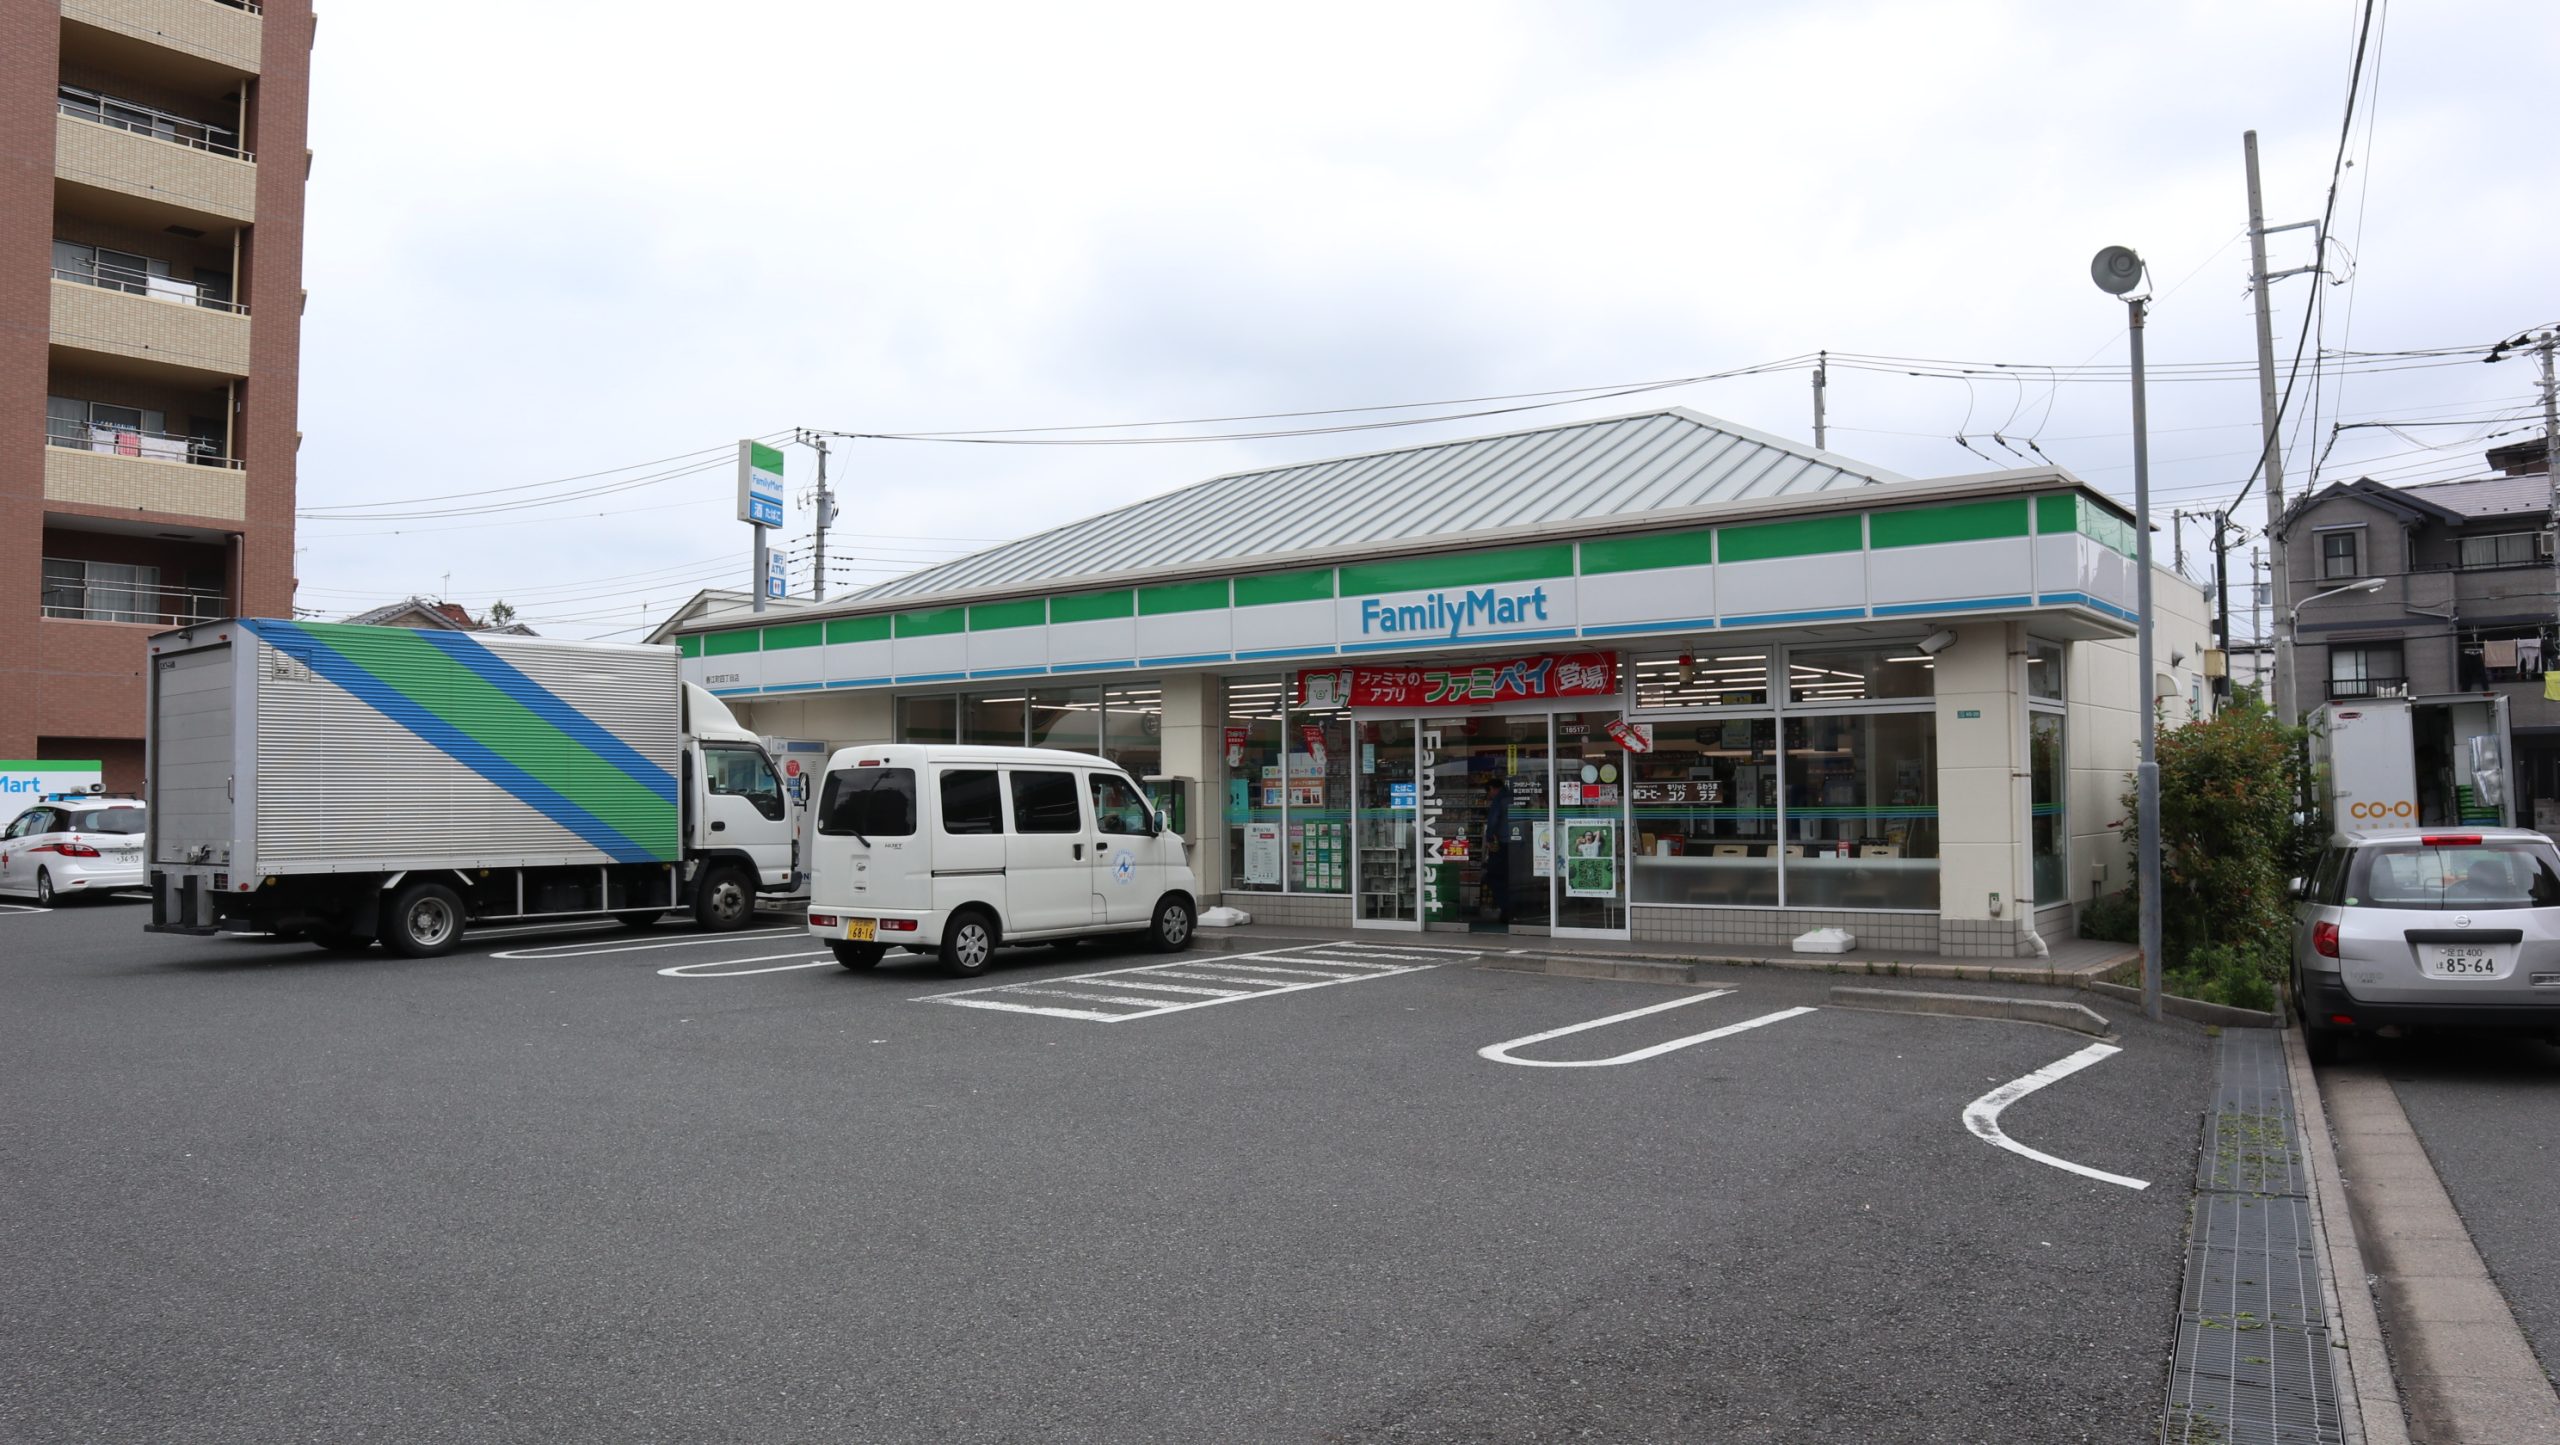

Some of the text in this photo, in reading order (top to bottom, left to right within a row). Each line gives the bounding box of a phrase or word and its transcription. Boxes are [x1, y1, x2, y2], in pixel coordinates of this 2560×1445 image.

[751, 473, 783, 492] FamilyMart
[754, 503, 781, 521] 酒 たばこ
[771, 565, 785, 576] ATM
[1361, 585, 1548, 639] FamilyMart
[1359, 658, 1605, 702] ファミマの ファミペイ 登場
[1370, 687, 1407, 703] アプリ
[1394, 784, 1413, 793] たばこ
[1632, 788, 1717, 801] 新コーヒー コク ラテ
[1666, 783, 1687, 791] キリッと
[1423, 730, 1444, 913] FamilyMart
[2447, 949, 2483, 957] 足立 400
[2446, 958, 2494, 973] 85-64
